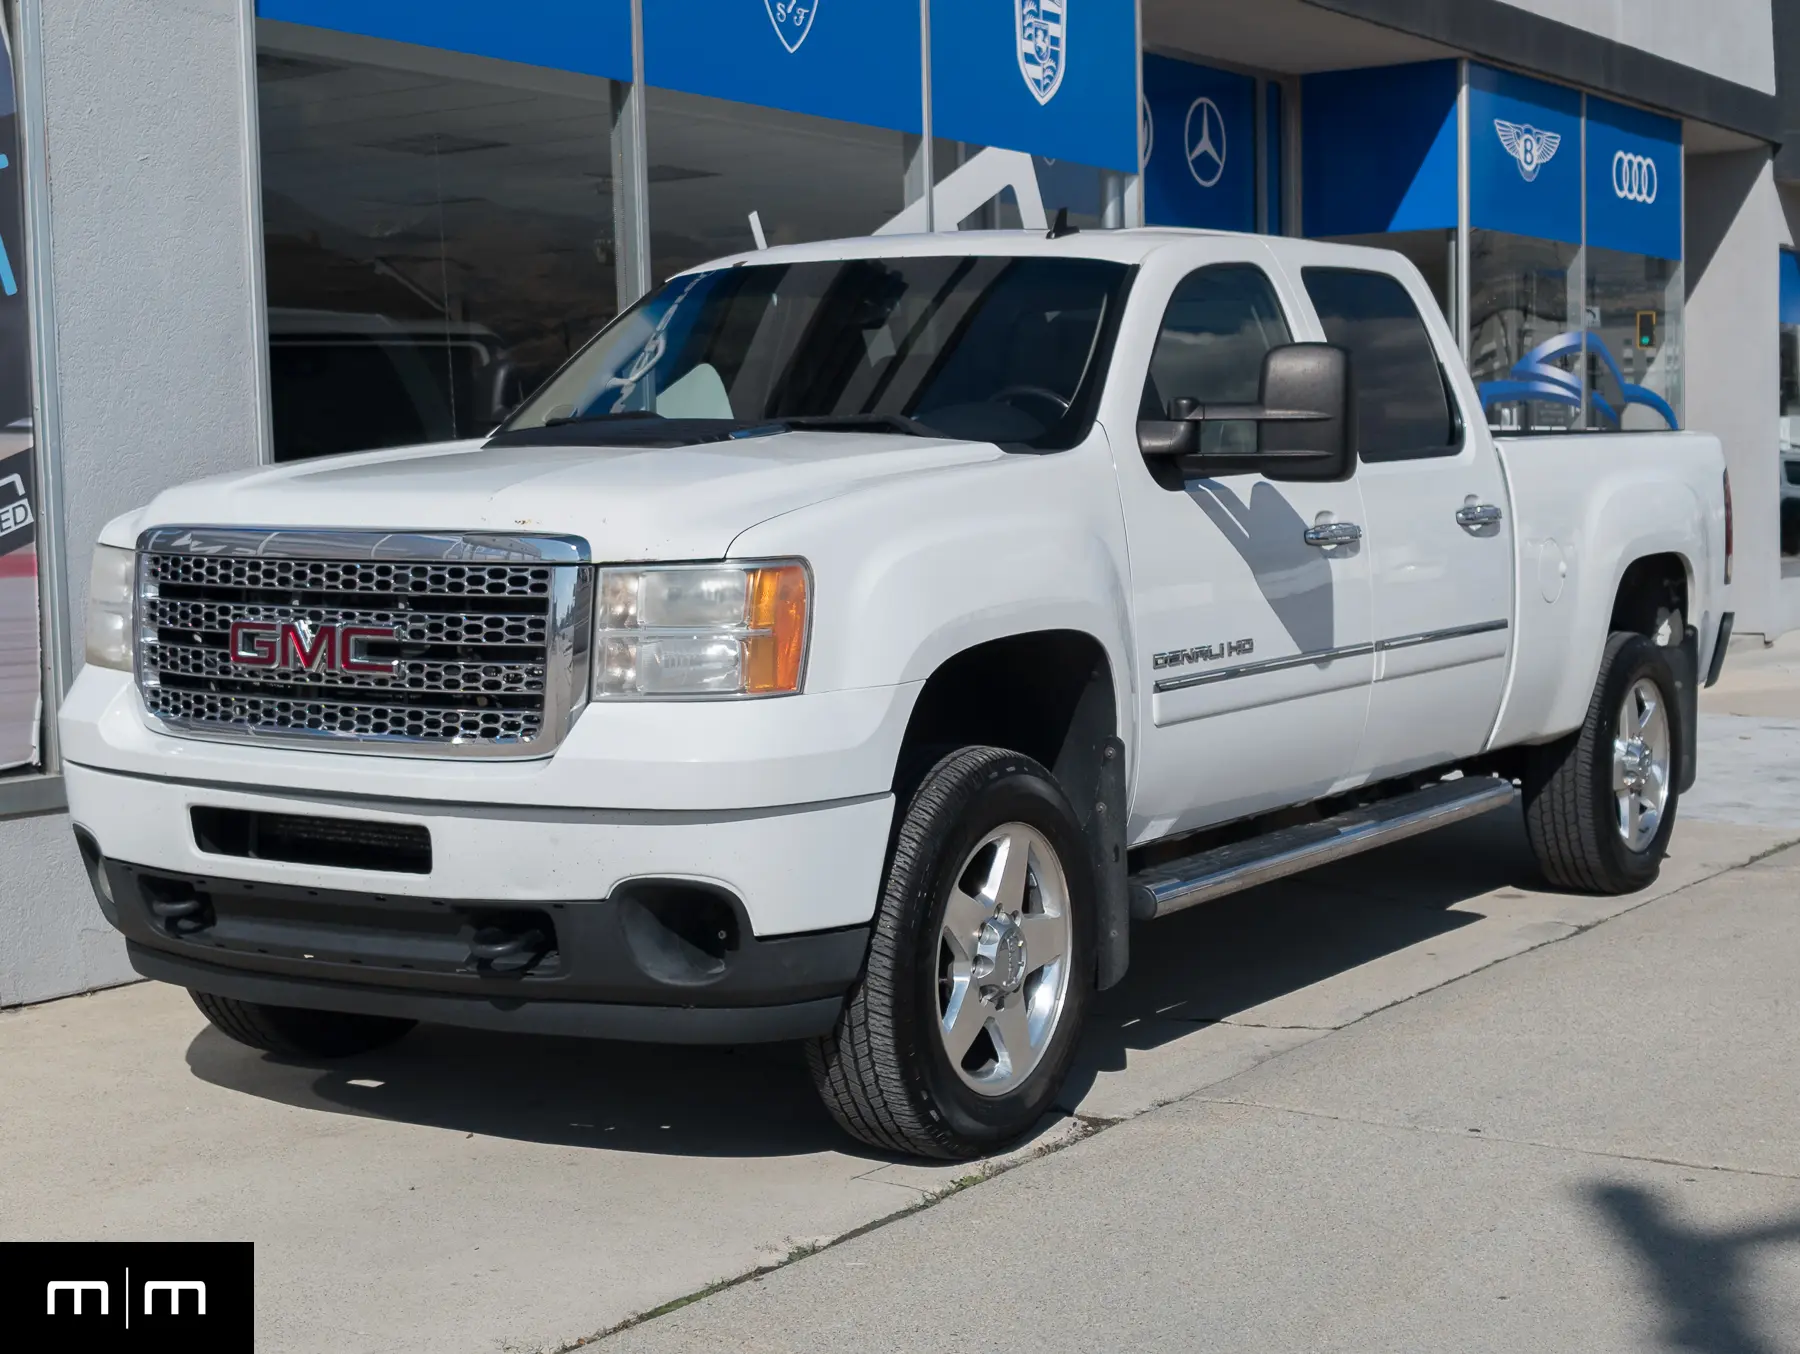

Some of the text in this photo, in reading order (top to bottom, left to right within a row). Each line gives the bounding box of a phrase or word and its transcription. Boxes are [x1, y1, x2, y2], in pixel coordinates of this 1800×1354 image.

[1523, 138, 1535, 165] B
[229, 619, 402, 677] GMC
[1153, 638, 1254, 670] DENALI HD
